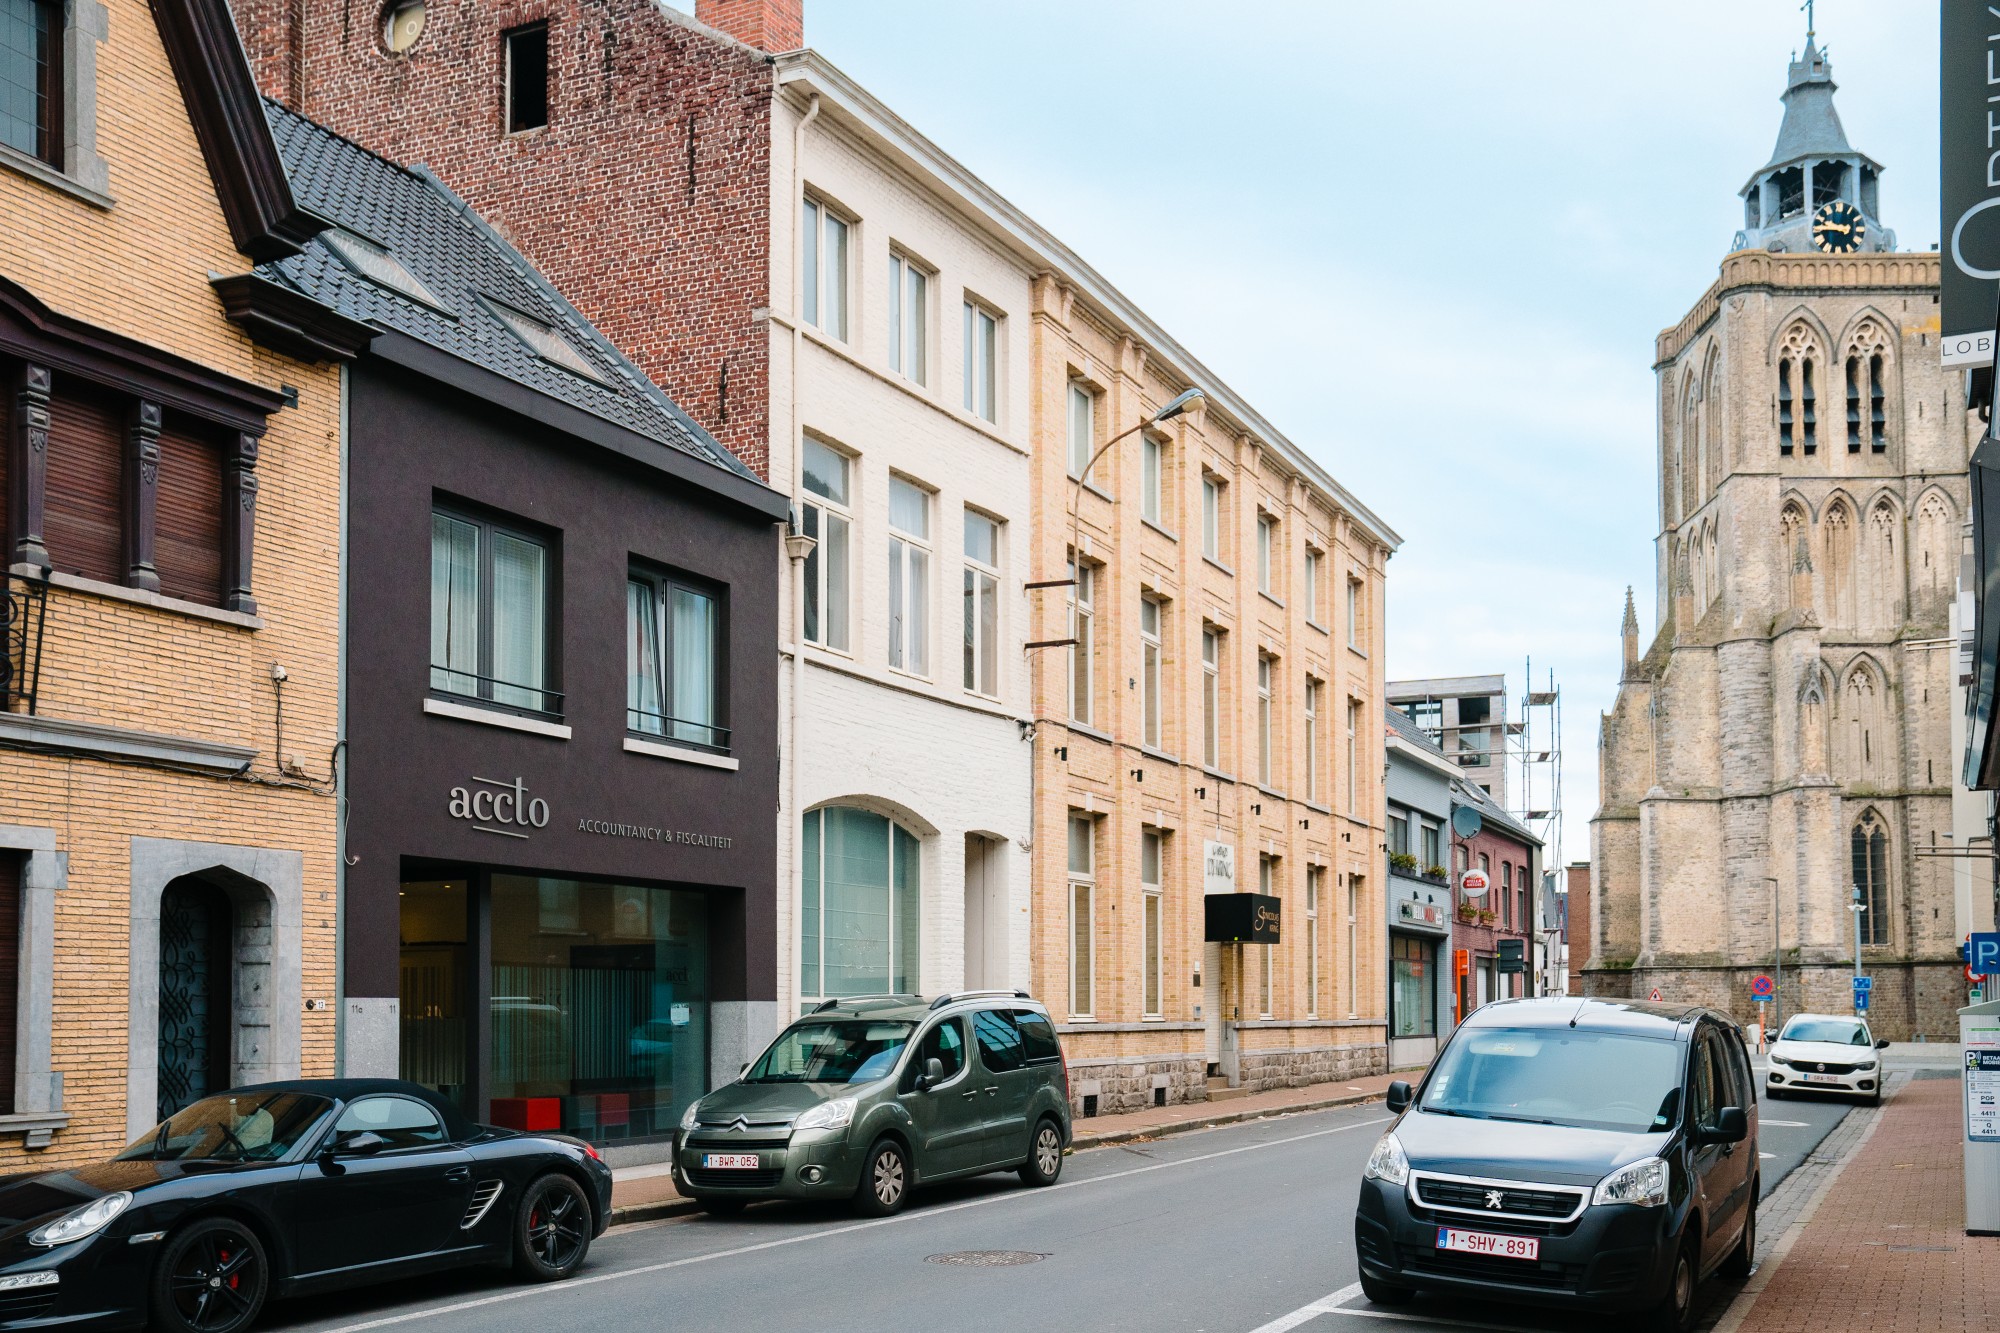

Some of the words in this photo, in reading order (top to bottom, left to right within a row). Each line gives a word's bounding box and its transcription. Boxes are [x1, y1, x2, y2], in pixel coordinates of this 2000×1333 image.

[448, 776, 550, 829] accto
[578, 818, 661, 842] ACCOUNTANCY
[664, 829, 673, 843] &
[675, 831, 733, 850] FISCALITEIT
[1978, 941, 1999, 966] P
[318, 1001, 324, 1009] 13
[1450, 1232, 1534, 1256] 1-SHV-891
